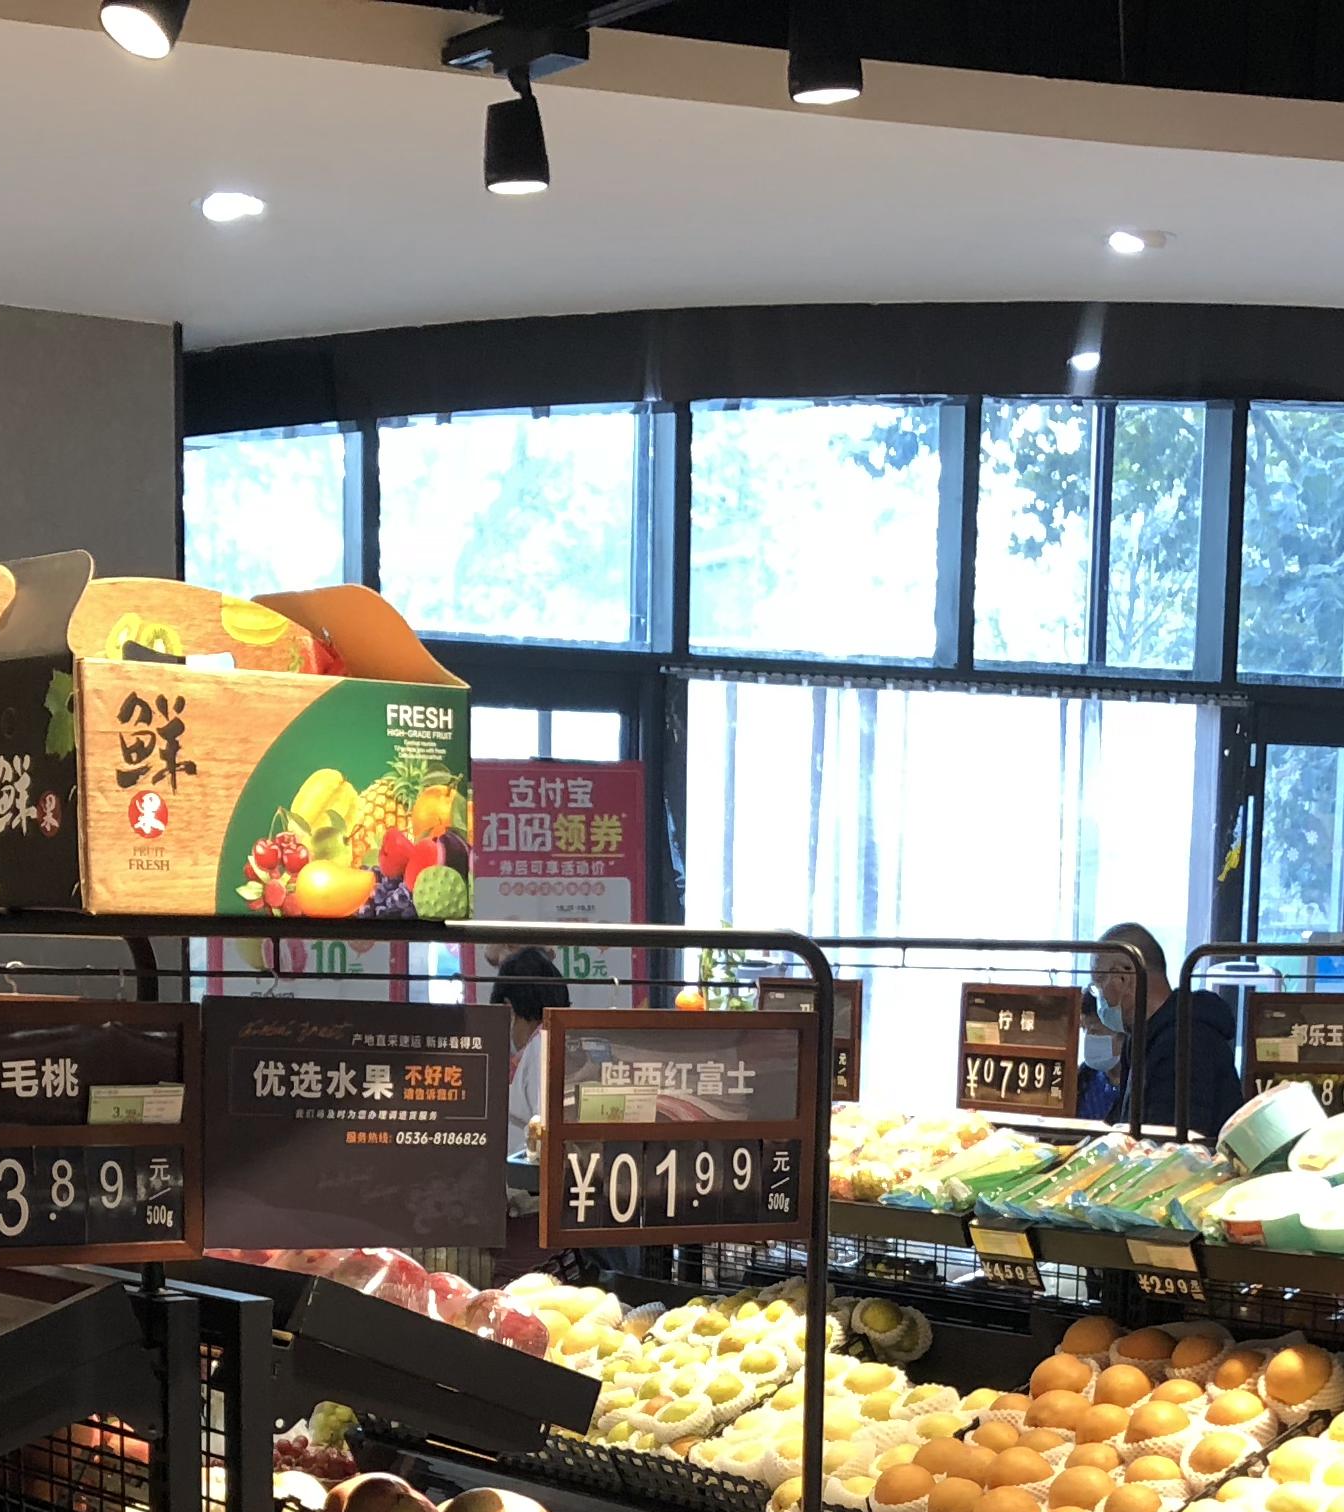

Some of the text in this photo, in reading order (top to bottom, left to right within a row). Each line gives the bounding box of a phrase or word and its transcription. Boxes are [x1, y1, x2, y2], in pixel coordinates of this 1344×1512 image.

[386, 703, 454, 730] FRESH
[114, 691, 198, 796] 鲜
[509, 776, 594, 808] 支付宝
[482, 812, 623, 853] 扫码领券
[128, 858, 170, 871] FRESH
[1, 1058, 79, 1099] 毛桃
[254, 1060, 394, 1101] 优选水果
[404, 1065, 463, 1087] 不好吃
[601, 1061, 756, 1096] 陕西红富士
[395, 1131, 487, 1146] 0536-8186826
[567, 1147, 753, 1223] ¥01.99
